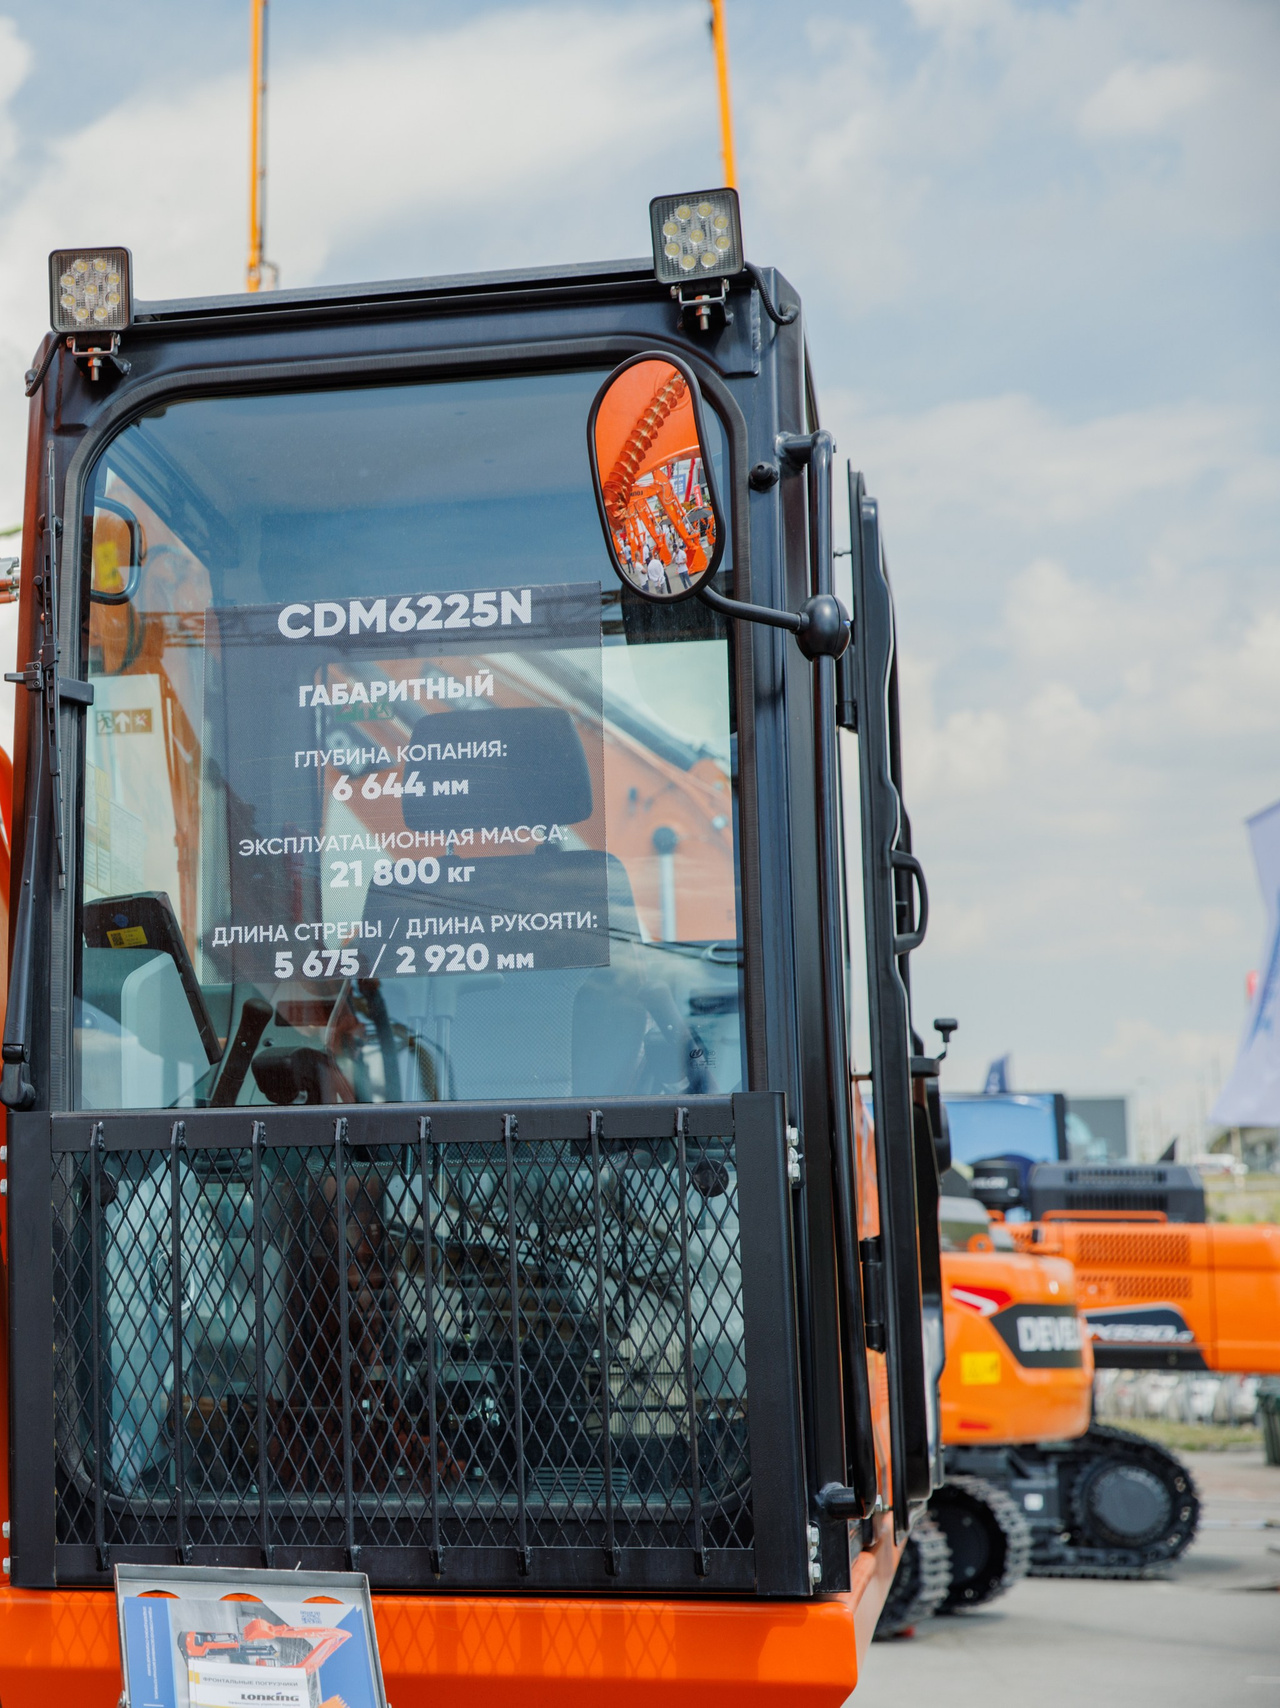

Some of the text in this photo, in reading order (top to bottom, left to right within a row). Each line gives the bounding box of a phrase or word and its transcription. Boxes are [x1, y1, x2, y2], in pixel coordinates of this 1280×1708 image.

[277, 589, 533, 639] CDM6225N
[298, 669, 495, 707] ГАБАРИТНЫЙ
[294, 740, 509, 768] ГЛУБИНА КОПАНИЯ:
[332, 771, 469, 801] 6 644 мм
[238, 823, 569, 857] ЭКСПЛУАТАЦИОННАЯ МАССА:
[329, 857, 476, 888] 21 800 кг
[212, 911, 599, 948] ДЛИНА СТРЕЛЫ / ДЛИНА РУКОЯТИ:
[273, 942, 535, 979] 5 675 / 2 920 мм
[203, 1676, 254, 1686] ФРОНТАЛЬНЫЕ
